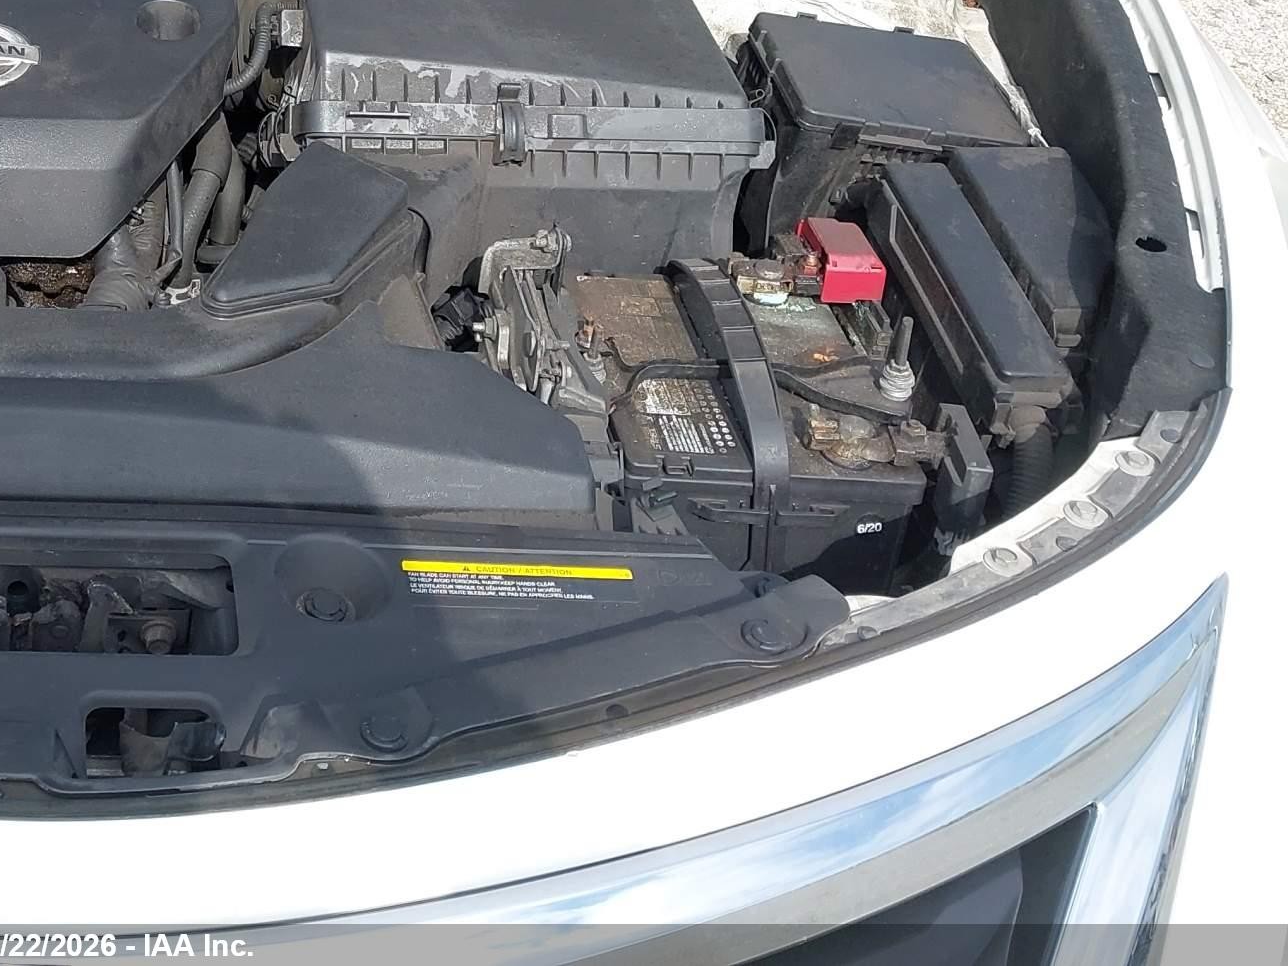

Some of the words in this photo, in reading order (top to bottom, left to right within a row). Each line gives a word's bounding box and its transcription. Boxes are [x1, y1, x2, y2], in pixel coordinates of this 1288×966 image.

[857, 522, 882, 534] 6/20
[475, 565, 515, 574] CAUTION
[524, 567, 572, 575] ATTENTION
